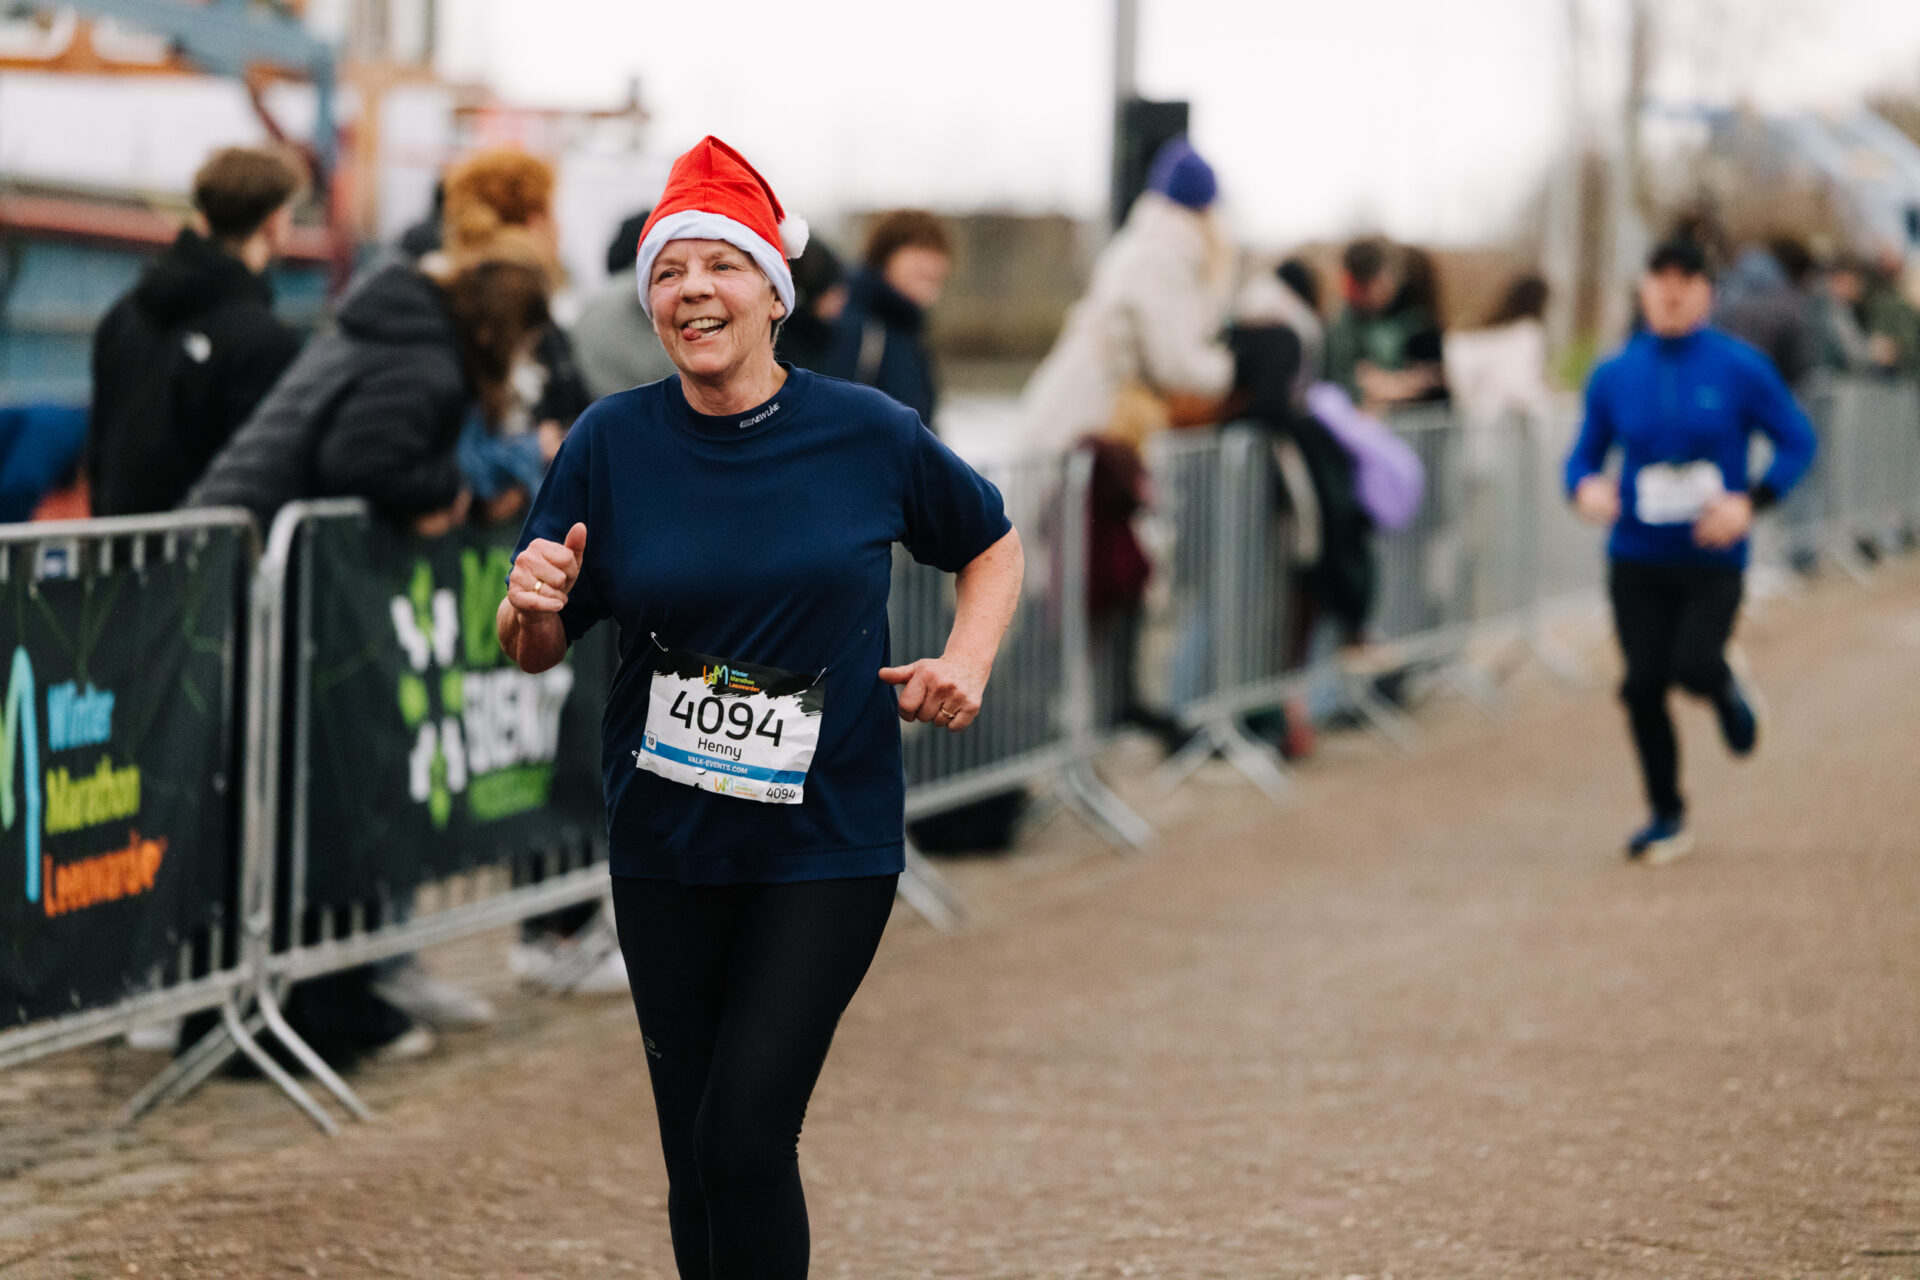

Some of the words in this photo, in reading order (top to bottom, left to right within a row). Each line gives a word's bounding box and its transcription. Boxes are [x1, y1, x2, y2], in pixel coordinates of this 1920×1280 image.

[47, 680, 116, 751] Winter
[669, 690, 784, 748] 4094
[687, 755, 748, 774] VALK-EVENTS.COM
[697, 736, 742, 761] Henny
[45, 754, 141, 836] Marathon
[766, 787, 796, 799] 4094
